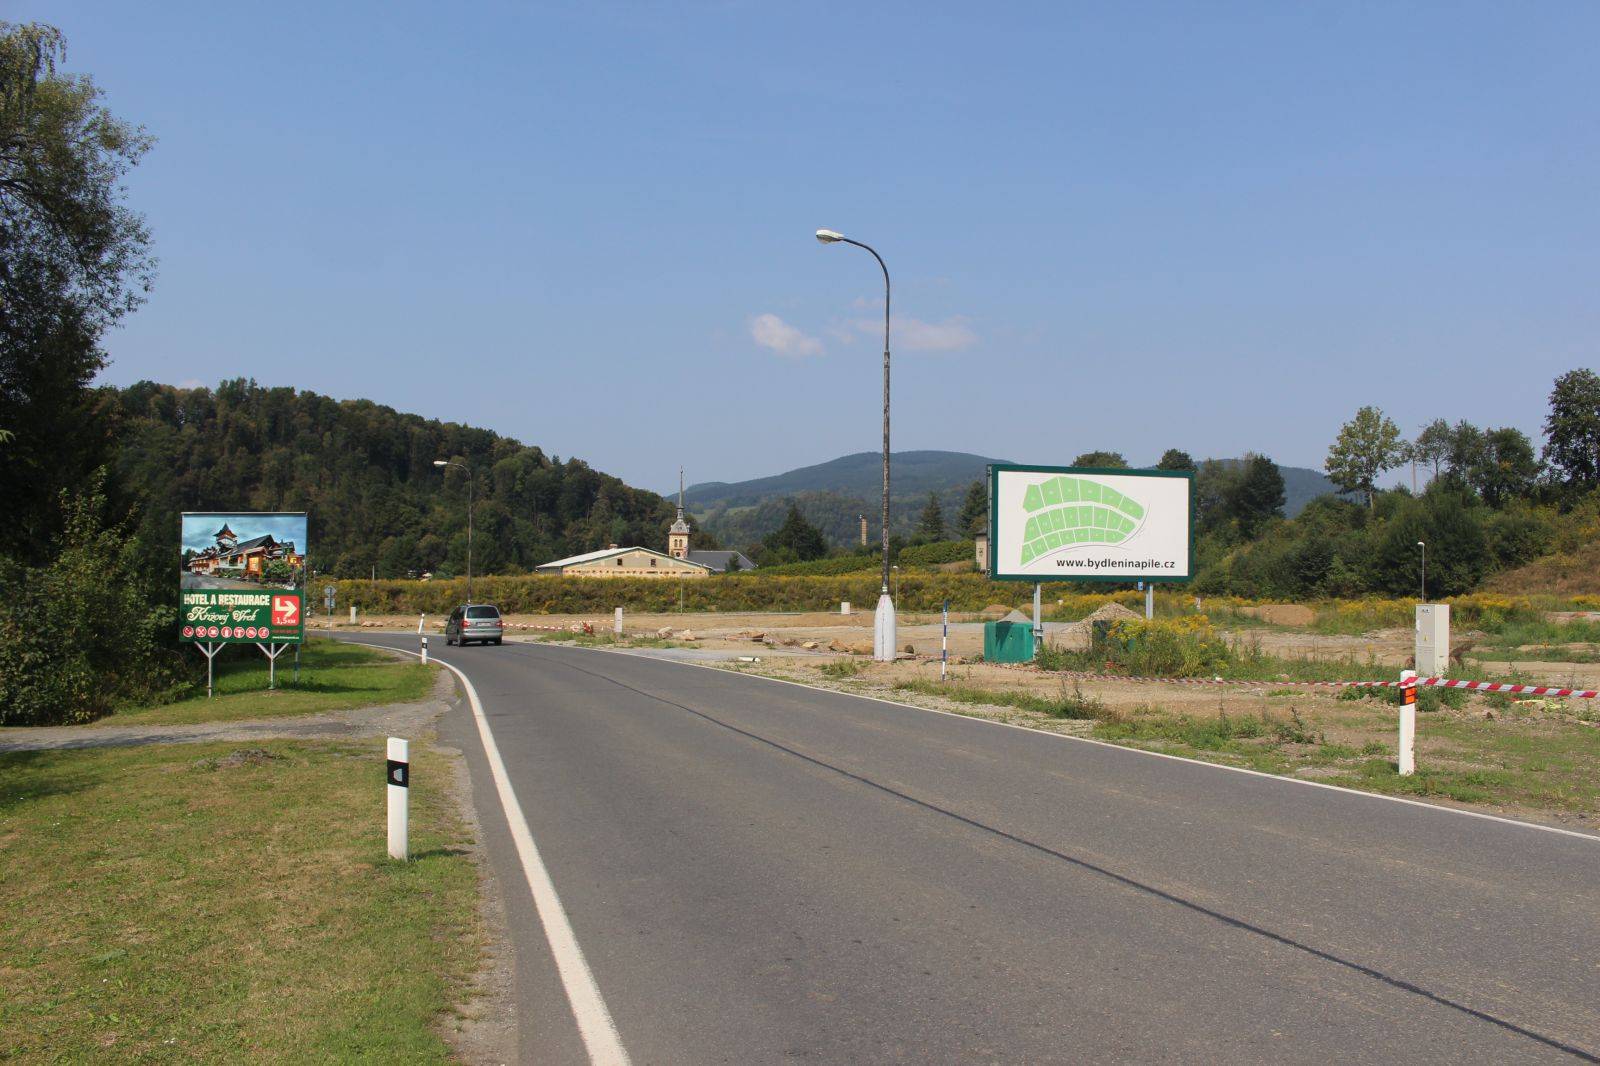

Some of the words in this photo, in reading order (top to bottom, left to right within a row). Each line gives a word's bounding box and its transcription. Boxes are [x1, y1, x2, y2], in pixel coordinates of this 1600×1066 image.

[1056, 558, 1175, 570] www.bydleninapile.cz
[183, 593, 209, 605] HOTEL
[210, 594, 217, 605] A
[218, 594, 270, 606] RESTAURACE
